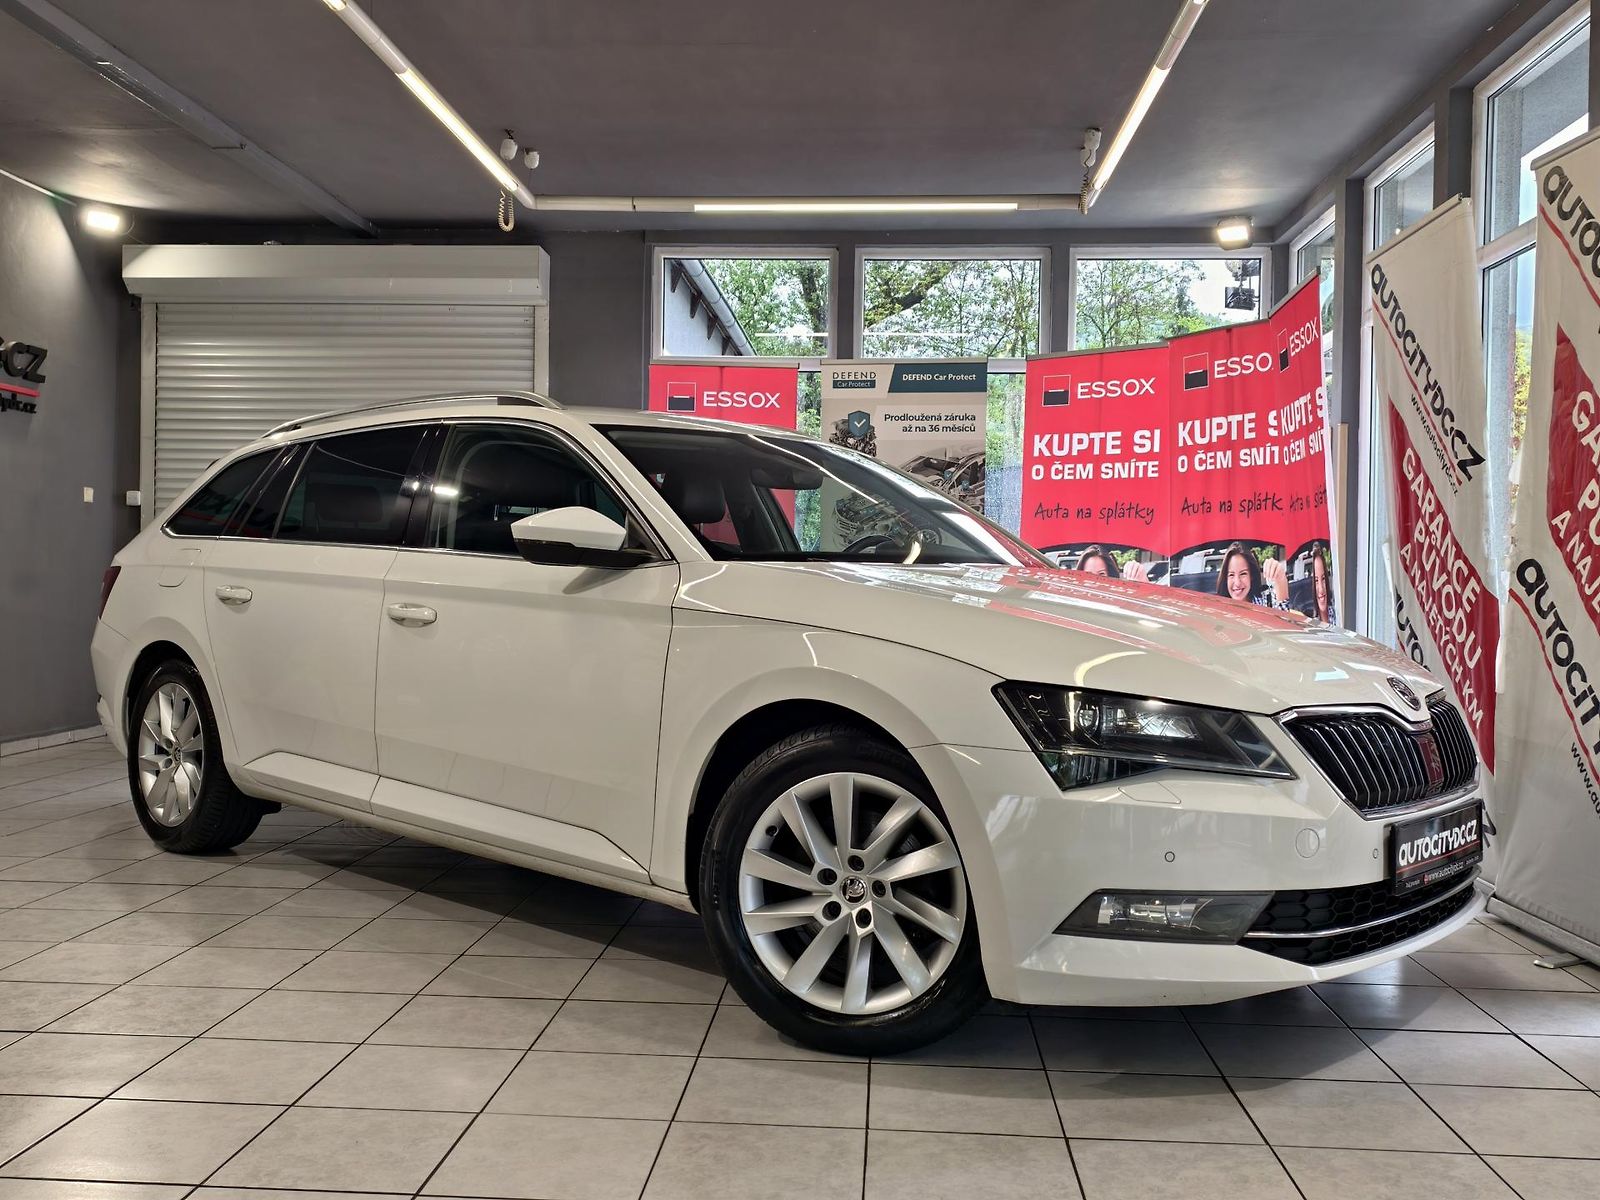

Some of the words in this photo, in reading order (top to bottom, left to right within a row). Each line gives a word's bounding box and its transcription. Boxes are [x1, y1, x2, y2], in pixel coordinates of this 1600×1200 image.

[1289, 317, 1319, 357] ESSOX
[832, 371, 877, 379] DEFEND
[1214, 352, 1274, 379] ESSO
[703, 391, 781, 408] ESSOX
[1077, 377, 1156, 399] ESSOX
[884, 413, 942, 422] Prodloužená
[944, 413, 976, 422] záruka
[1280, 392, 1313, 436] KUPTE
[1316, 386, 1326, 417] S
[942, 423, 976, 432] měsíců
[1178, 412, 1256, 447] KUPTE
[1268, 410, 1279, 437] S
[1572, 391, 1600, 467] GA
[1033, 431, 1122, 457] KUPTE
[1133, 429, 1161, 454] SI
[1283, 446, 1289, 465] O
[1290, 437, 1306, 463] ČEM
[1031, 464, 1045, 480] O
[1050, 461, 1094, 480] ČEM
[1100, 459, 1159, 479] SNÍTE
[1177, 455, 1188, 473] O
[1193, 449, 1232, 471] ČEM
[1239, 443, 1279, 467] SNÍT
[1034, 502, 1069, 519] Auta
[1076, 507, 1092, 519] na
[1099, 501, 1155, 525] splátky
[1181, 496, 1212, 515] Auta
[1219, 499, 1233, 513] na
[1238, 492, 1283, 518] splátk
[1402, 448, 1480, 613] GARANCE
[1551, 510, 1571, 539] A
[1414, 518, 1482, 670] PŮVODU
[1400, 543, 1411, 565] A
[1411, 560, 1463, 683] NAJETÝCH
[1462, 680, 1484, 729] KM
[1571, 742, 1600, 818] www.au
